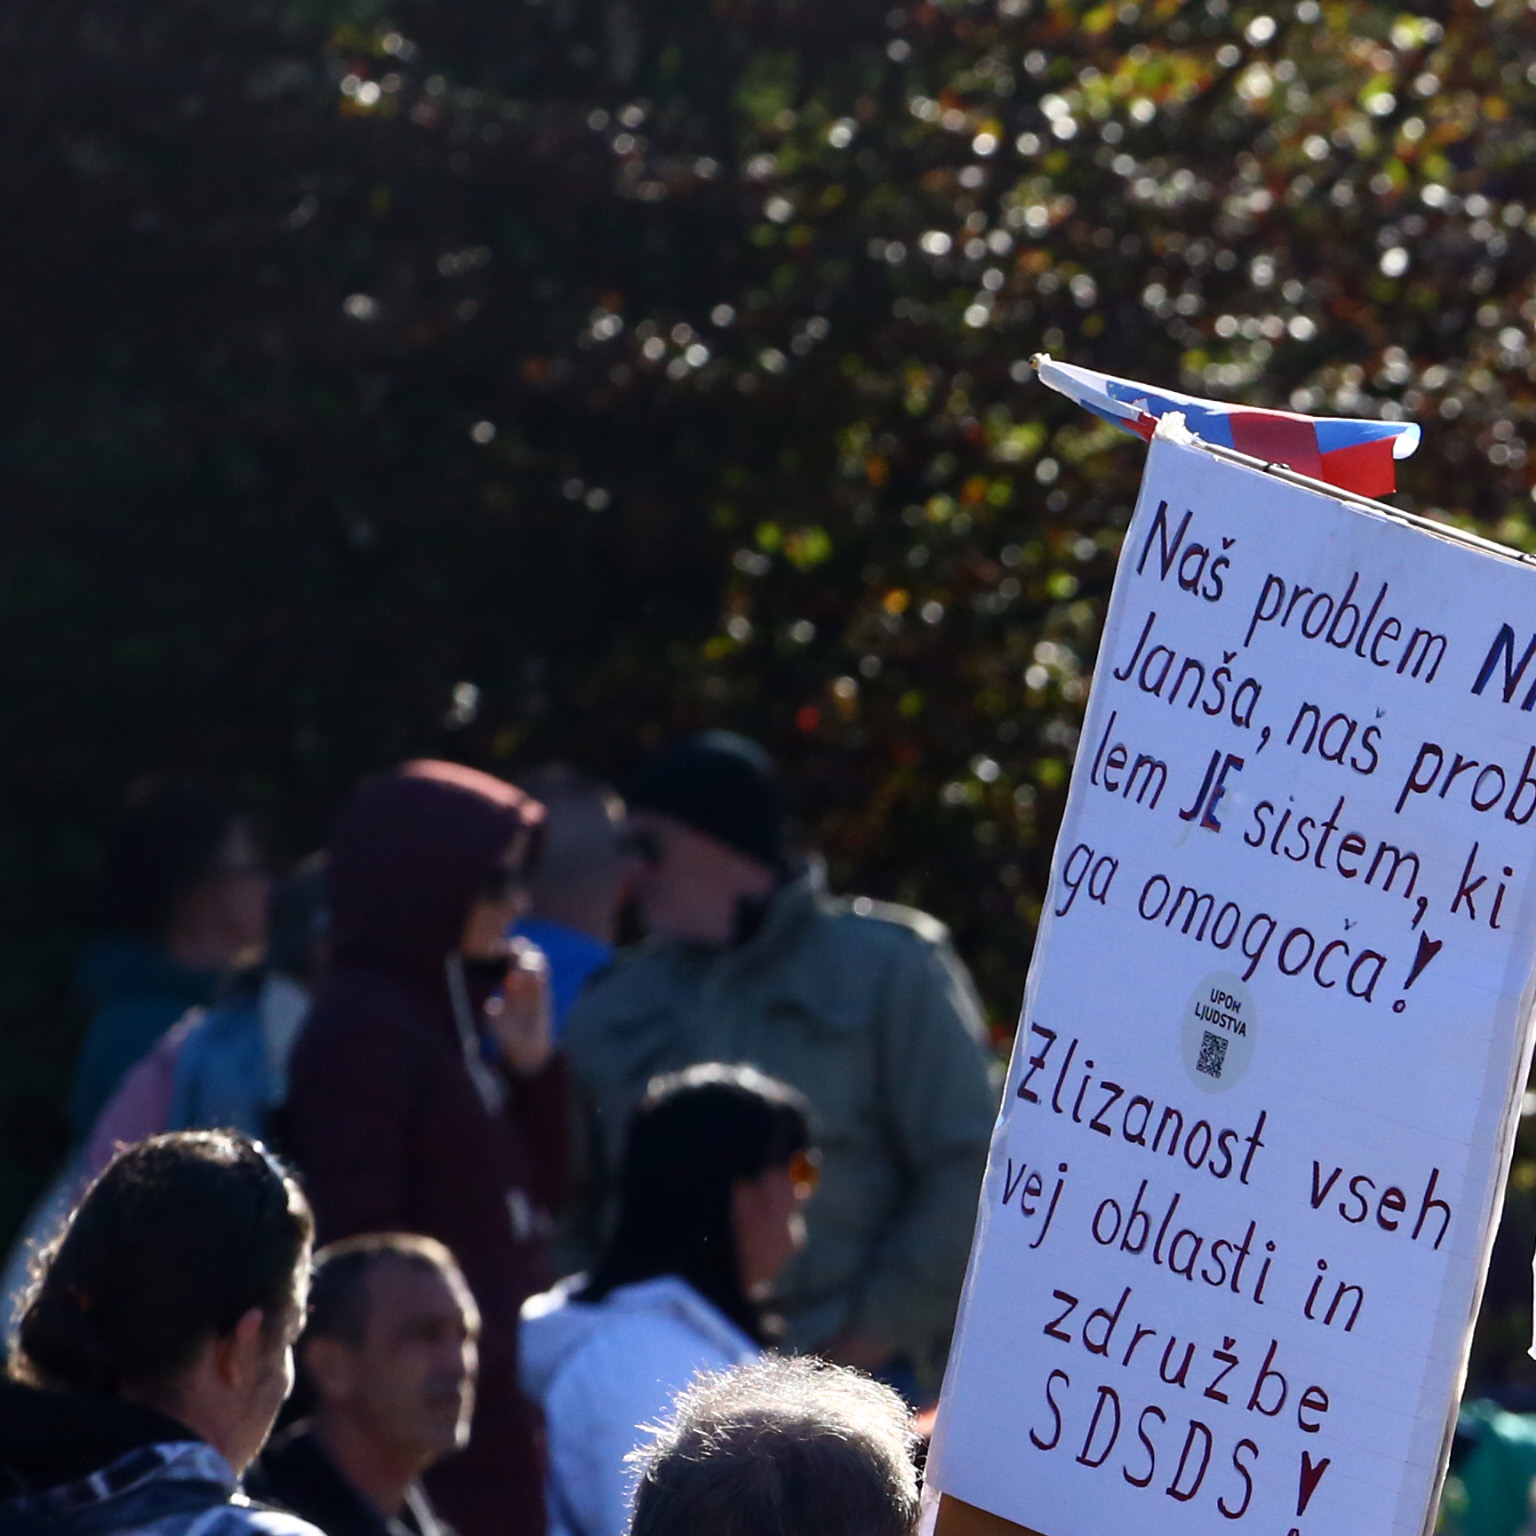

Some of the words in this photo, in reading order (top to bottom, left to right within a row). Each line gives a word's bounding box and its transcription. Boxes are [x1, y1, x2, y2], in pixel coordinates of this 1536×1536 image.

[1136, 500, 1236, 602] Naš
[1244, 572, 1447, 684] problem
[1113, 612, 1272, 753] Janša,
[1287, 700, 1387, 775] naš
[1056, 842, 1118, 917] ga
[1090, 711, 1167, 809] lem
[1179, 749, 1244, 832] JE
[1244, 795, 1429, 930] sistem,
[1451, 841, 1514, 929] ki
[1195, 1002, 1246, 1037] LJUDSTVA
[1210, 988, 1241, 1013] UPOR
[1002, 1158, 1067, 1249] vej
[1091, 1180, 1277, 1304] oblasti
[1303, 1259, 1364, 1332] in
[1310, 1160, 1451, 1250] vseh
[1044, 1287, 1329, 1433] združbe
